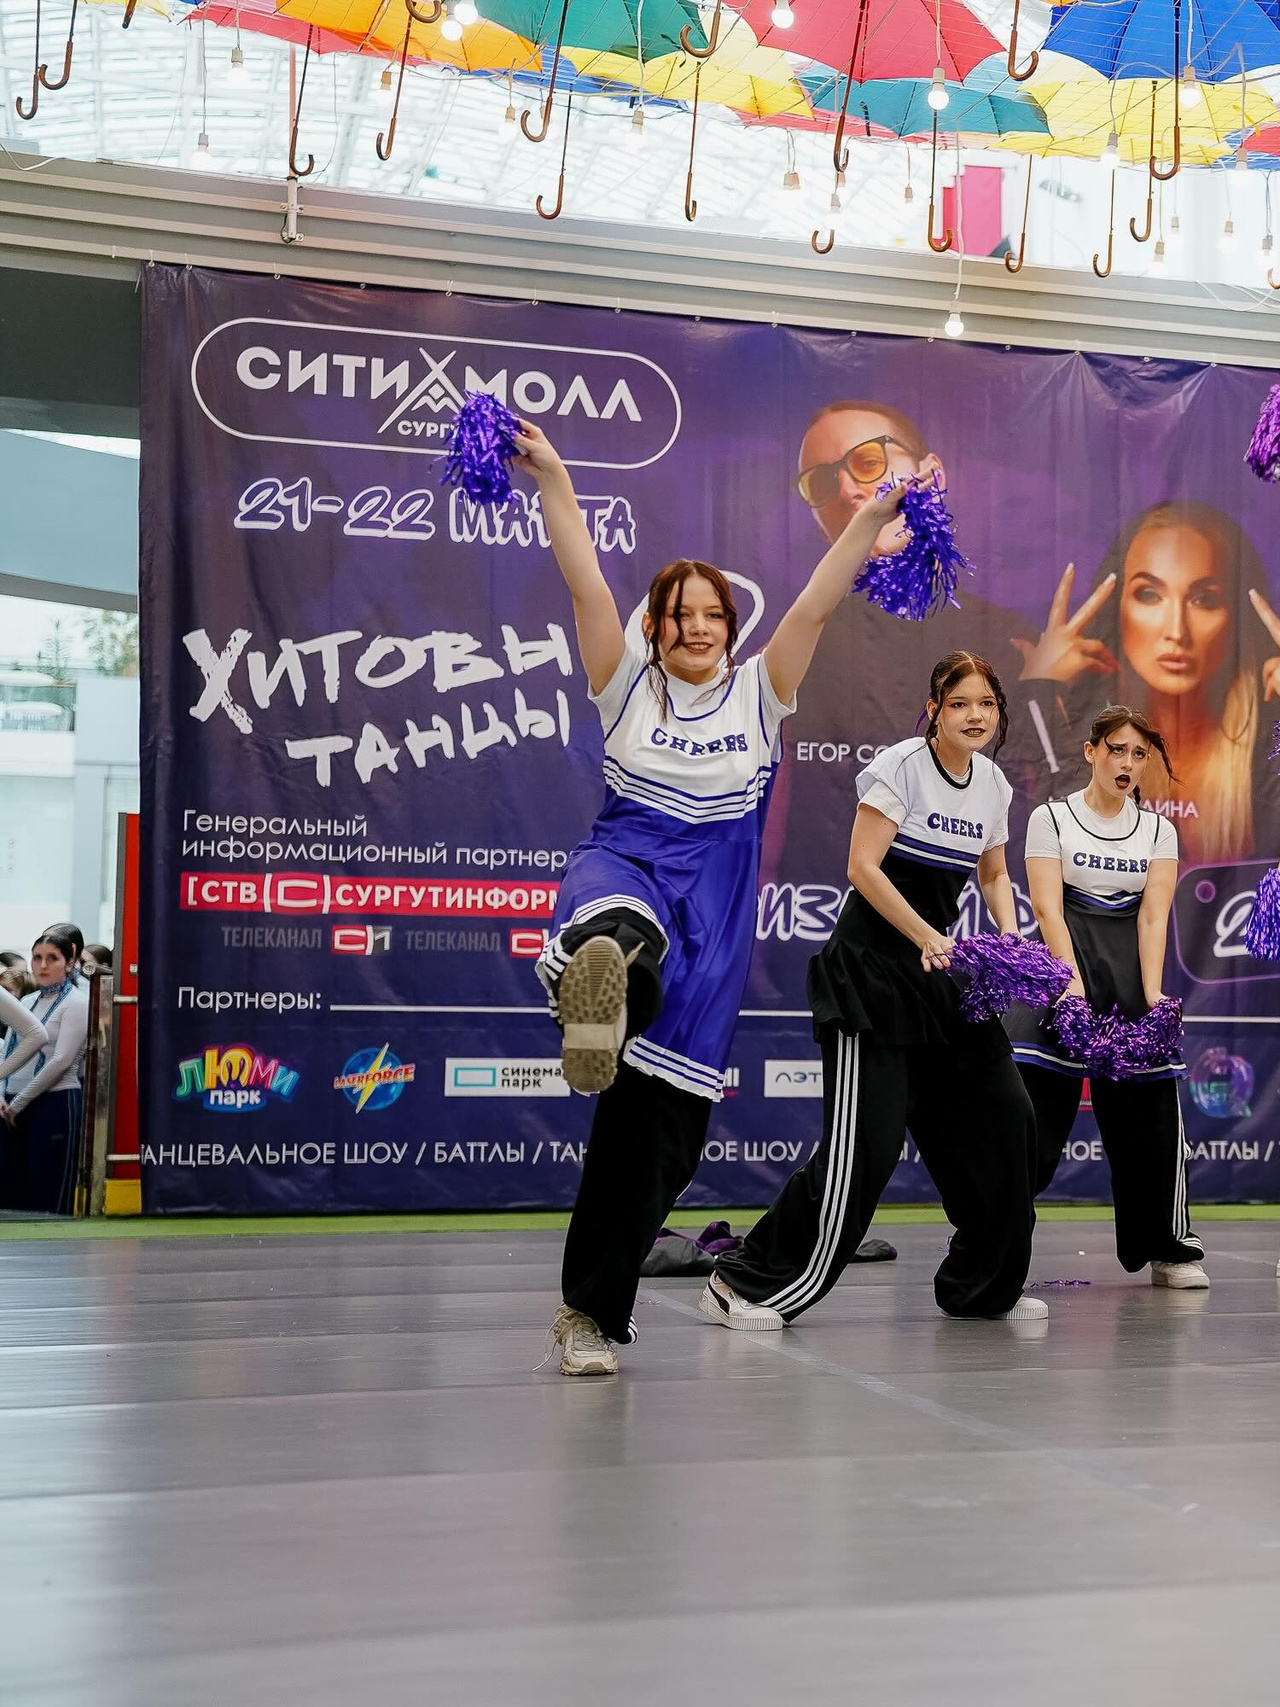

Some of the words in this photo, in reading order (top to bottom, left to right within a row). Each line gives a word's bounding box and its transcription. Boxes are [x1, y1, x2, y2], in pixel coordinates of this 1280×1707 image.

[236, 346, 409, 400] СИТИ
[465, 365, 642, 422] МОЛЛ
[398, 419, 457, 440] СУРГУ
[233, 477, 436, 541] 21-22
[182, 622, 573, 735] ХИТОВЫ
[284, 687, 571, 788] ТАНЦЫ
[796, 741, 851, 763] ЕГОР
[183, 809, 367, 838] Генеральный
[927, 812, 984, 840] CHEERS
[182, 835, 447, 864] информационный
[456, 847, 567, 872] партнер
[1072, 851, 1148, 874] CHEERS
[221, 926, 322, 949] ТЕЛЕКАНАЛ
[405, 930, 500, 951] ТЕЛЕКАНАЛ
[178, 986, 321, 1013] Партнеры:
[501, 1067, 562, 1077] синема
[501, 1078, 542, 1091] парк
[210, 1089, 261, 1108] парк
[343, 1142, 408, 1164] ШОУ
[434, 1141, 525, 1164] БАТТЛЫ
[744, 1140, 803, 1162] ШОУ
